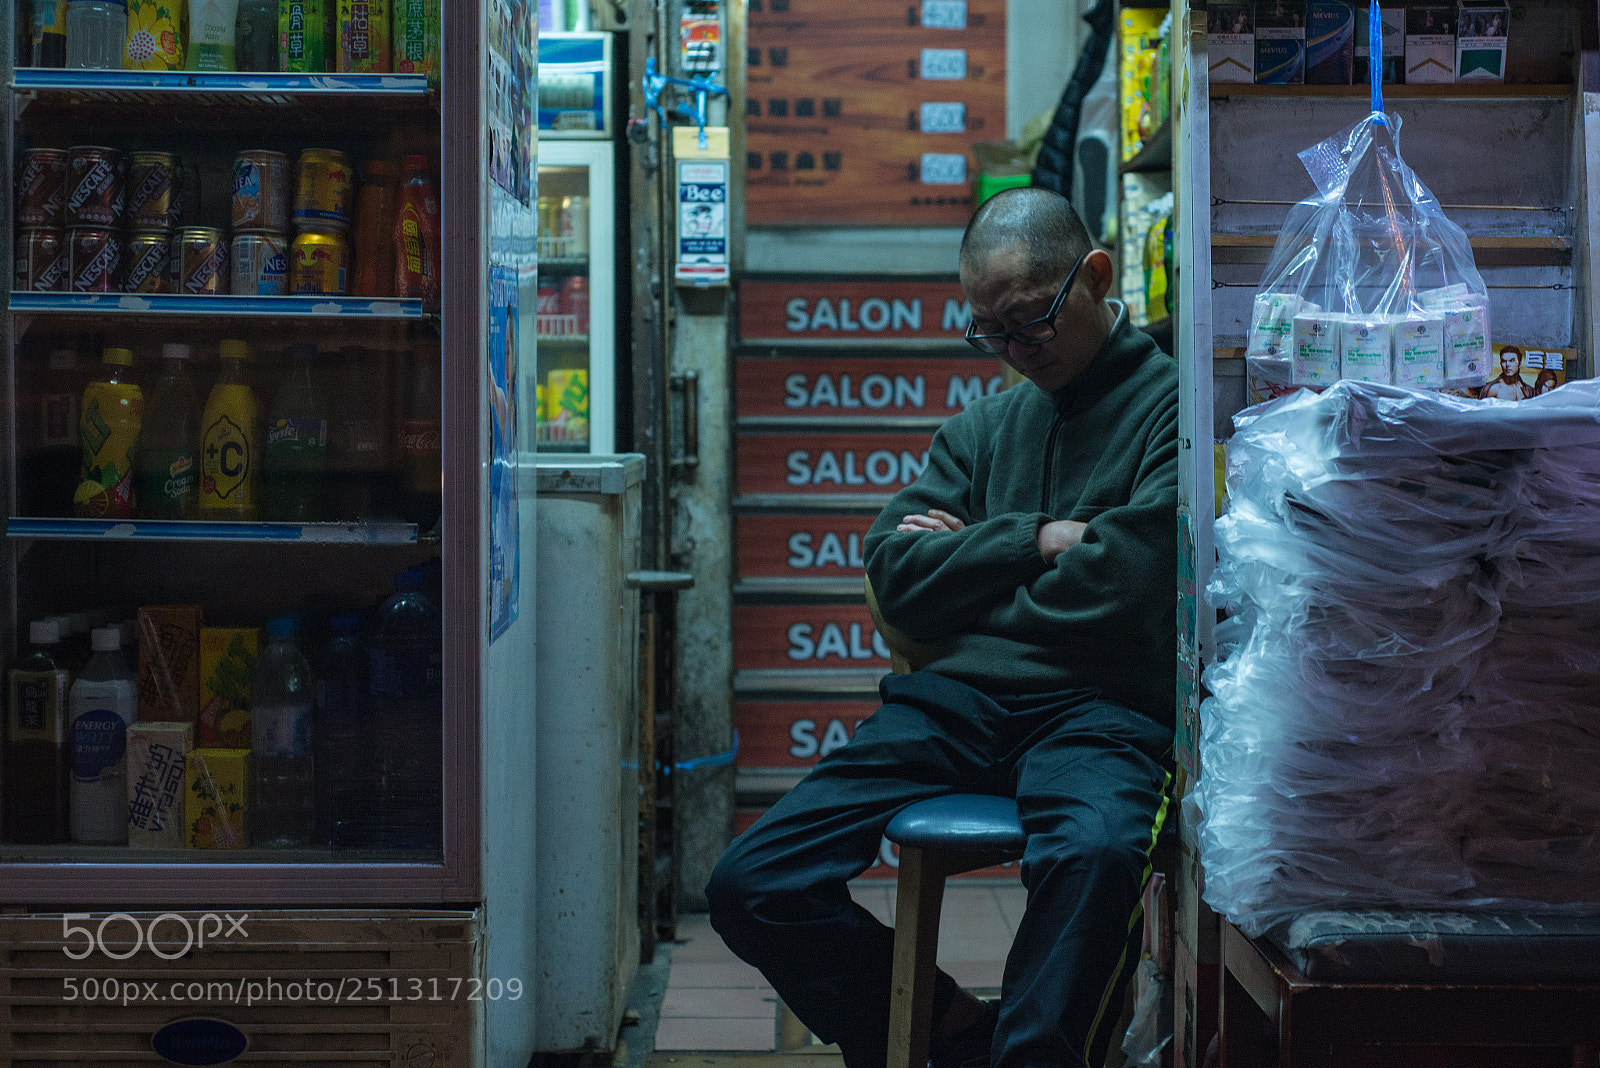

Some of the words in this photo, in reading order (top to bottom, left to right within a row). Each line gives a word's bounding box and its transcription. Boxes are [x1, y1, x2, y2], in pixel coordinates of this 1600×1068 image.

[686, 184, 724, 200] Bee
[785, 298, 922, 331] SALON
[1524, 350, 1564, 371] 巨星
[784, 374, 925, 408] SALON
[786, 449, 930, 486] SALON
[164, 475, 194, 494] Cream
[75, 720, 118, 731] ENERGY
[789, 718, 864, 758] SA
